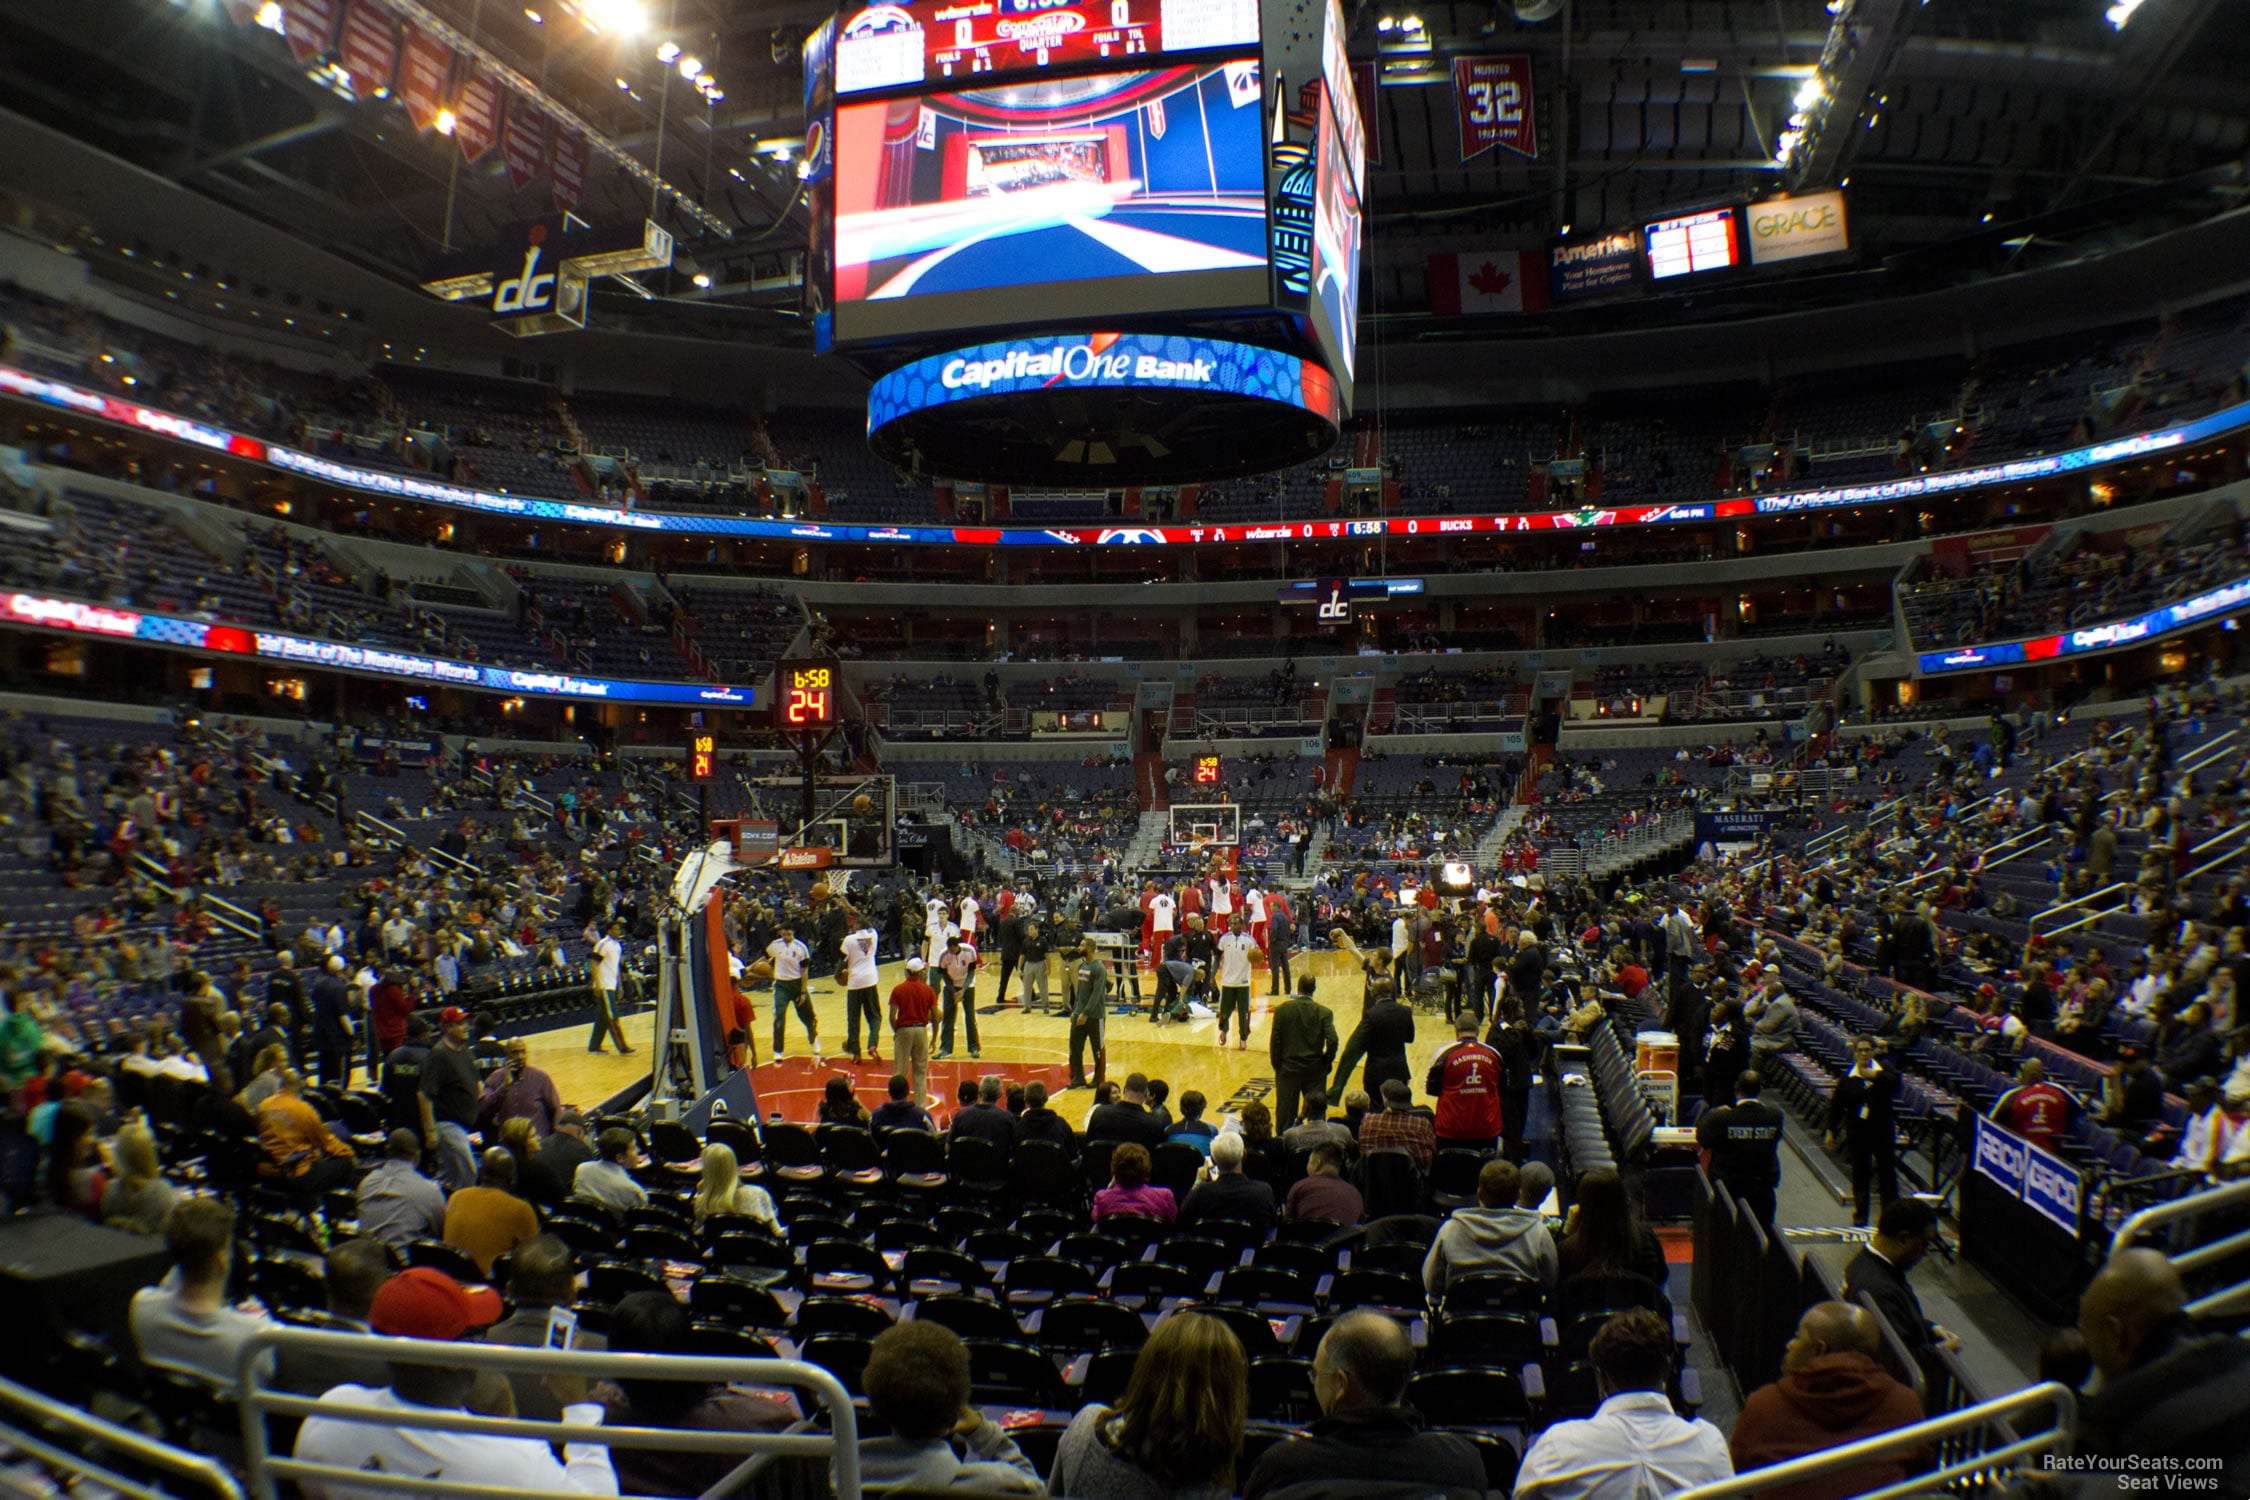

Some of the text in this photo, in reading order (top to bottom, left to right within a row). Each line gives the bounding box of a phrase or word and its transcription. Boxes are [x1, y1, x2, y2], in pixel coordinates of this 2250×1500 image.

[956, 19, 972, 48] 0
[1019, 35, 1062, 52] QUARTER
[1468, 81, 1522, 123] 32
[1753, 205, 1838, 240] GRACE
[1135, 354, 1212, 383] Bank
[1303, 524, 1313, 539] 0
[1352, 522, 1382, 535] 6:58
[1407, 519, 1418, 533] 0
[1440, 518, 1473, 531] BUCKS
[1245, 525, 1293, 540] wizards
[794, 668, 830, 689] 6:58
[789, 690, 825, 723] 24
[695, 737, 713, 753] 6:58
[1305, 740, 1320, 748] 106
[1506, 735, 1522, 744] 105
[695, 754, 709, 777] 24
[1199, 757, 1218, 767] 6:58
[1196, 767, 1217, 782] 24
[1713, 815, 1764, 823] MASERATI
[1728, 1127, 1777, 1139] EVENT STAFF
[1981, 1130, 2026, 1180] GEICO
[2029, 1158, 2079, 1214] GEICO
